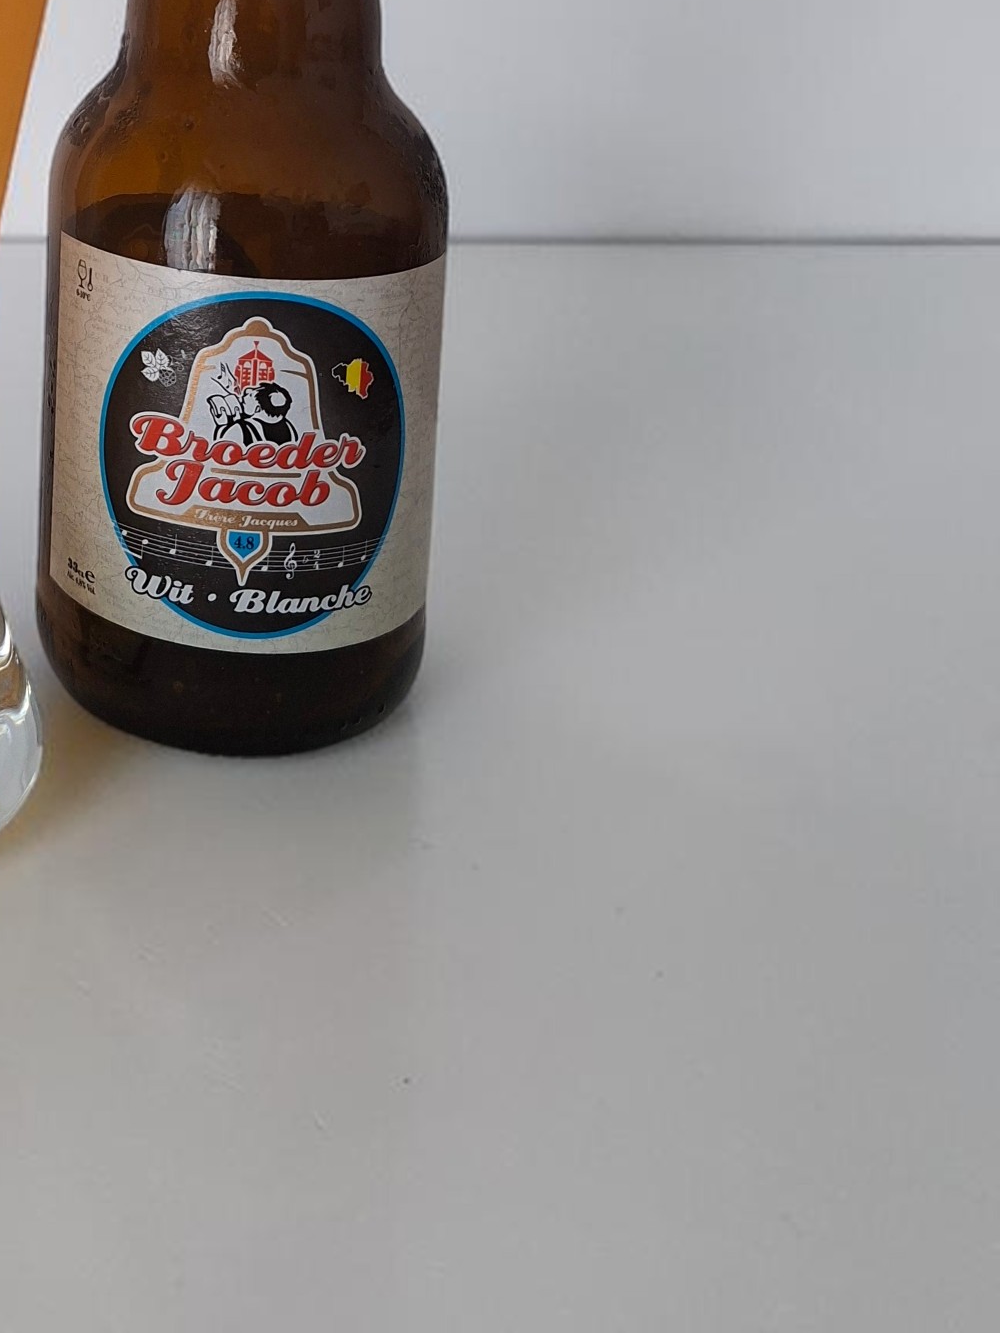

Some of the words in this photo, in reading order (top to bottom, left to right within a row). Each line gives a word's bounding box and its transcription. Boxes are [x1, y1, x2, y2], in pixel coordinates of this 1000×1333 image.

[132, 415, 363, 468] Broeder
[156, 459, 331, 507] Jacob
[234, 535, 255, 550] 4.8
[239, 514, 298, 530] Jacques
[126, 567, 194, 604] Wit
[229, 585, 371, 613] Blanche
